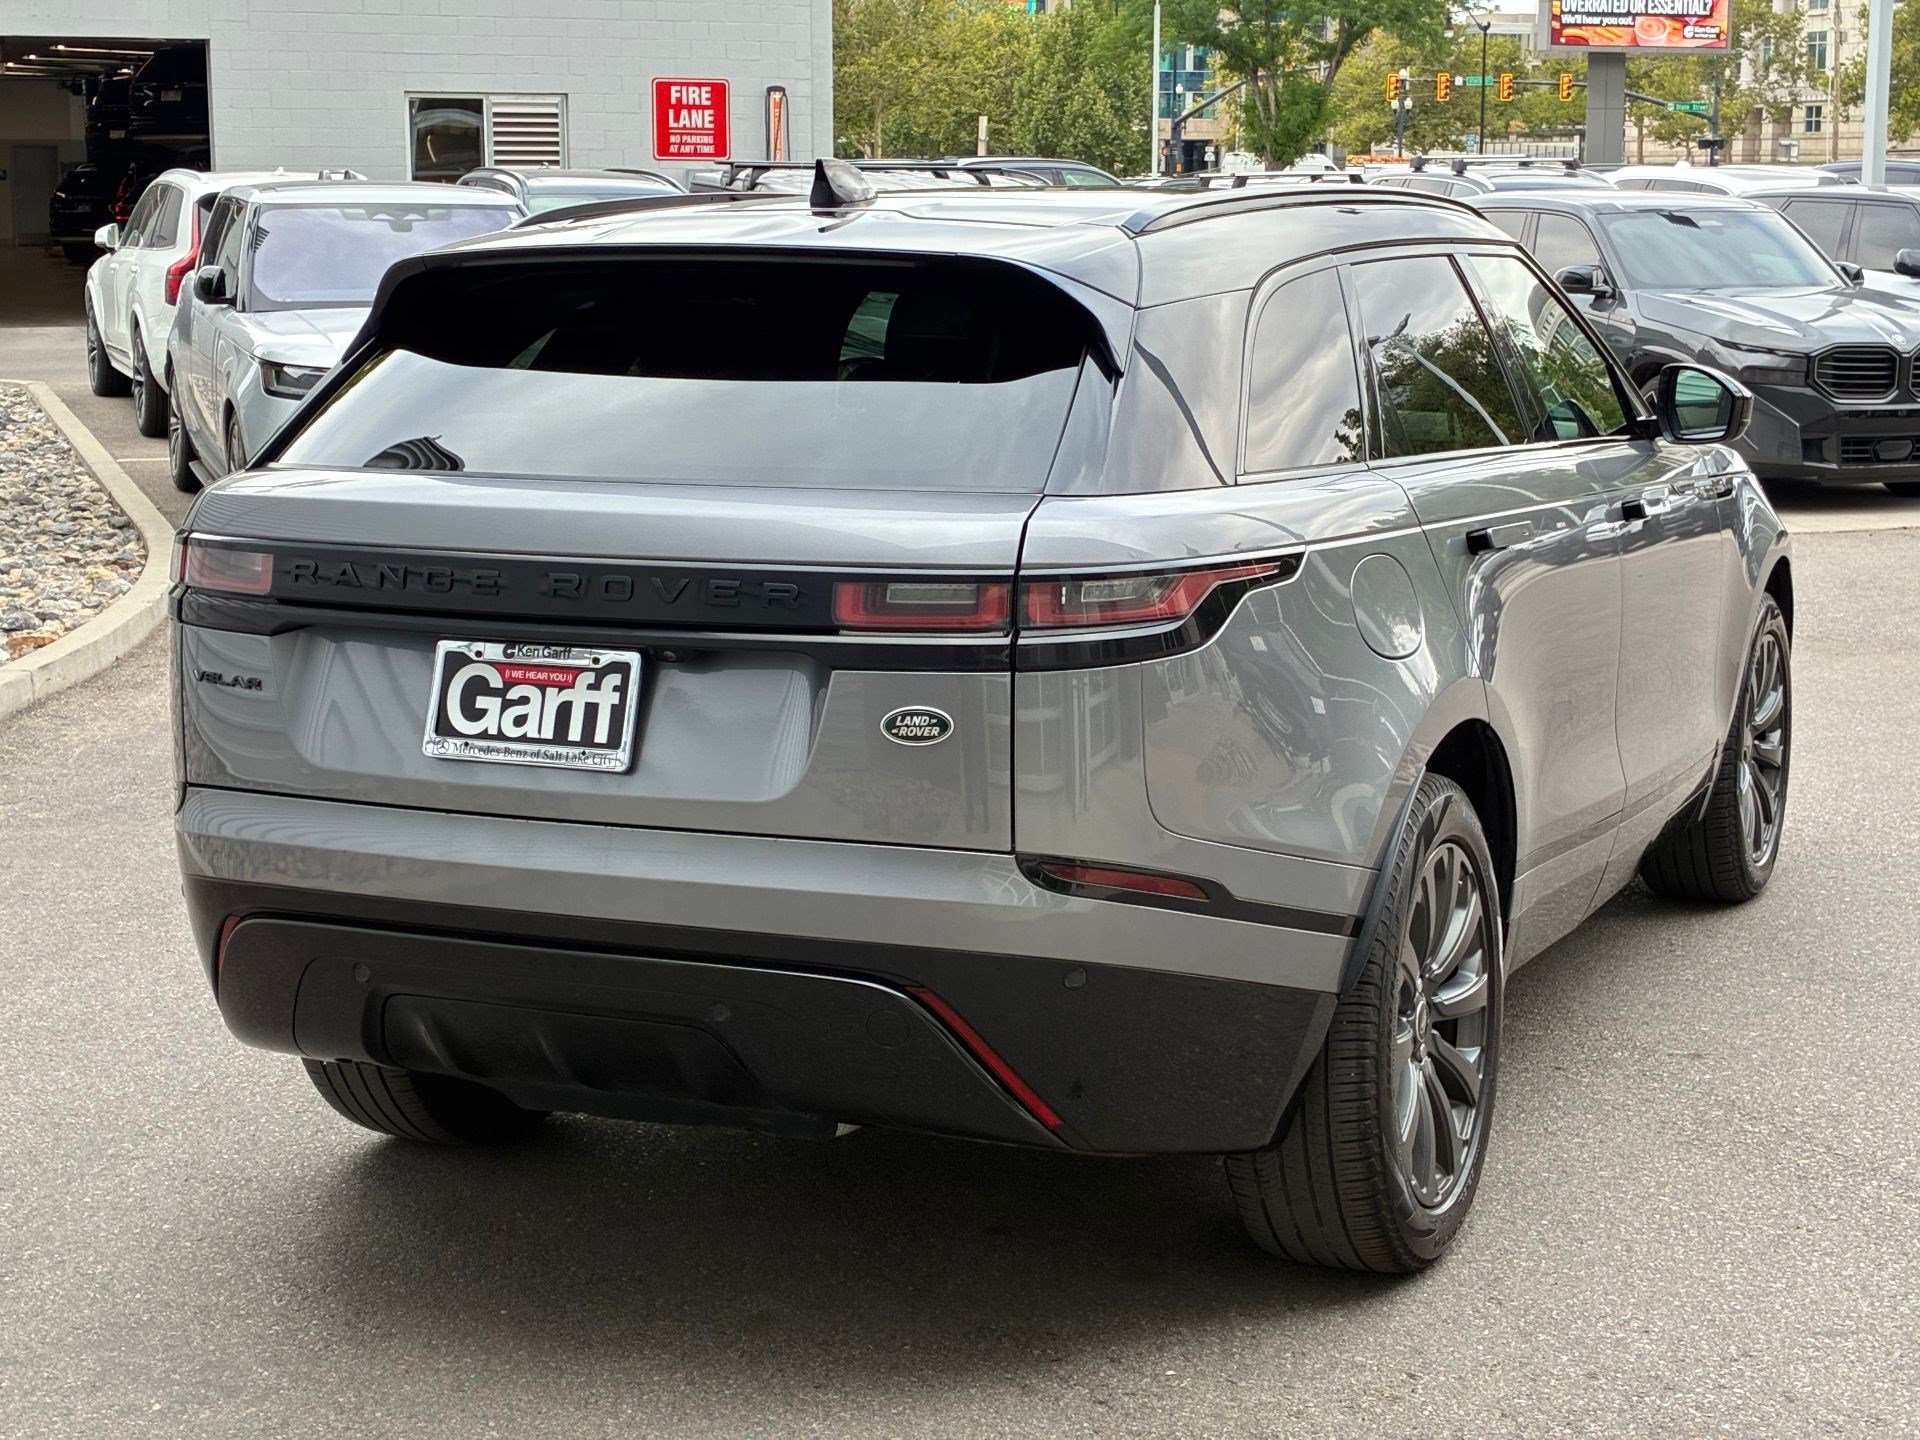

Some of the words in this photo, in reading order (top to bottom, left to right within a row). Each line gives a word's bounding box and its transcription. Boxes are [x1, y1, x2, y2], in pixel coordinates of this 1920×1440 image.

[1561, 0, 1628, 13] OVERRATED
[1629, 0, 1646, 14] OR
[1647, 0, 1713, 15] ESSENTIAL?
[1561, 14, 1582, 24] We'll
[1583, 14, 1601, 25] hear
[1602, 17, 1618, 26] you
[1618, 16, 1635, 25] out.
[670, 85, 712, 106] FIRE
[668, 108, 715, 129] LANE
[669, 134, 681, 144] NO
[682, 135, 714, 144] PARKING
[668, 144, 679, 154] AT
[680, 144, 696, 154] ANY
[696, 145, 716, 154] TIME
[289, 560, 501, 597] RANGE
[548, 572, 802, 609] ROVER
[517, 643, 540, 657] Ken
[542, 645, 572, 660] Garff
[192, 668, 263, 691] VELAR
[511, 670, 525, 679] WE
[525, 671, 549, 680] HEAR
[549, 672, 567, 682] YOU
[446, 662, 622, 744] Garff
[895, 715, 930, 726] LAND
[898, 726, 941, 737] ROVER
[452, 741, 528, 760] Mercedes-Benz
[530, 748, 541, 760] of
[543, 750, 564, 762] Salt
[565, 751, 590, 764] Lake
[592, 752, 615, 767] City
